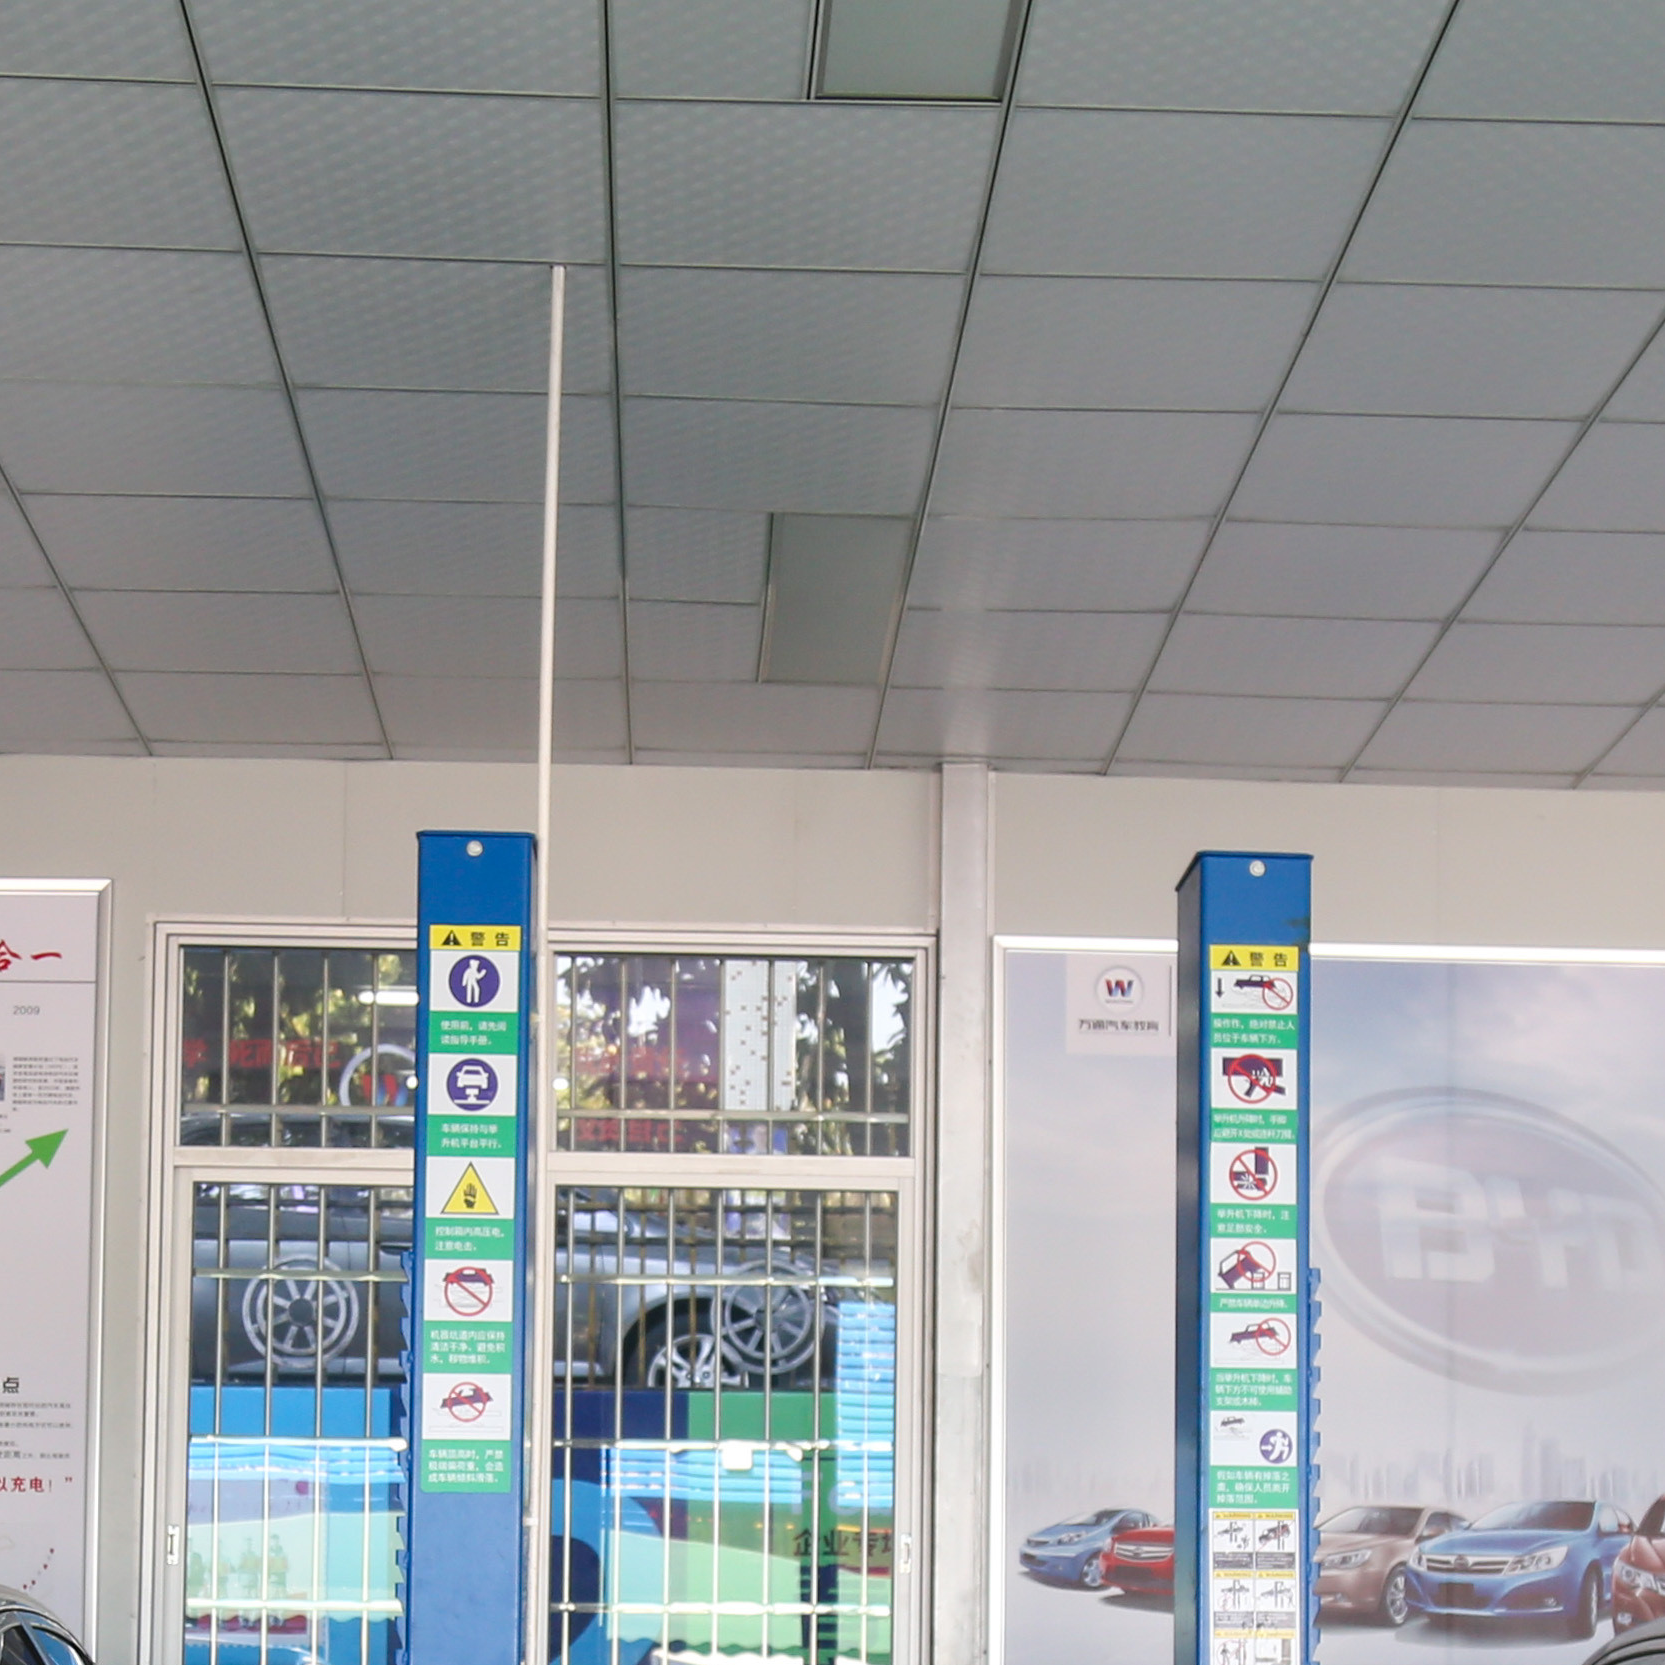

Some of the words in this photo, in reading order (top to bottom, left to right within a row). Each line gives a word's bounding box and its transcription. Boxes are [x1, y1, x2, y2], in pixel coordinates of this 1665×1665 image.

[470, 931, 510, 947] 警告
[1250, 951, 1288, 967] 警告
[12, 1005, 41, 1016] 2009
